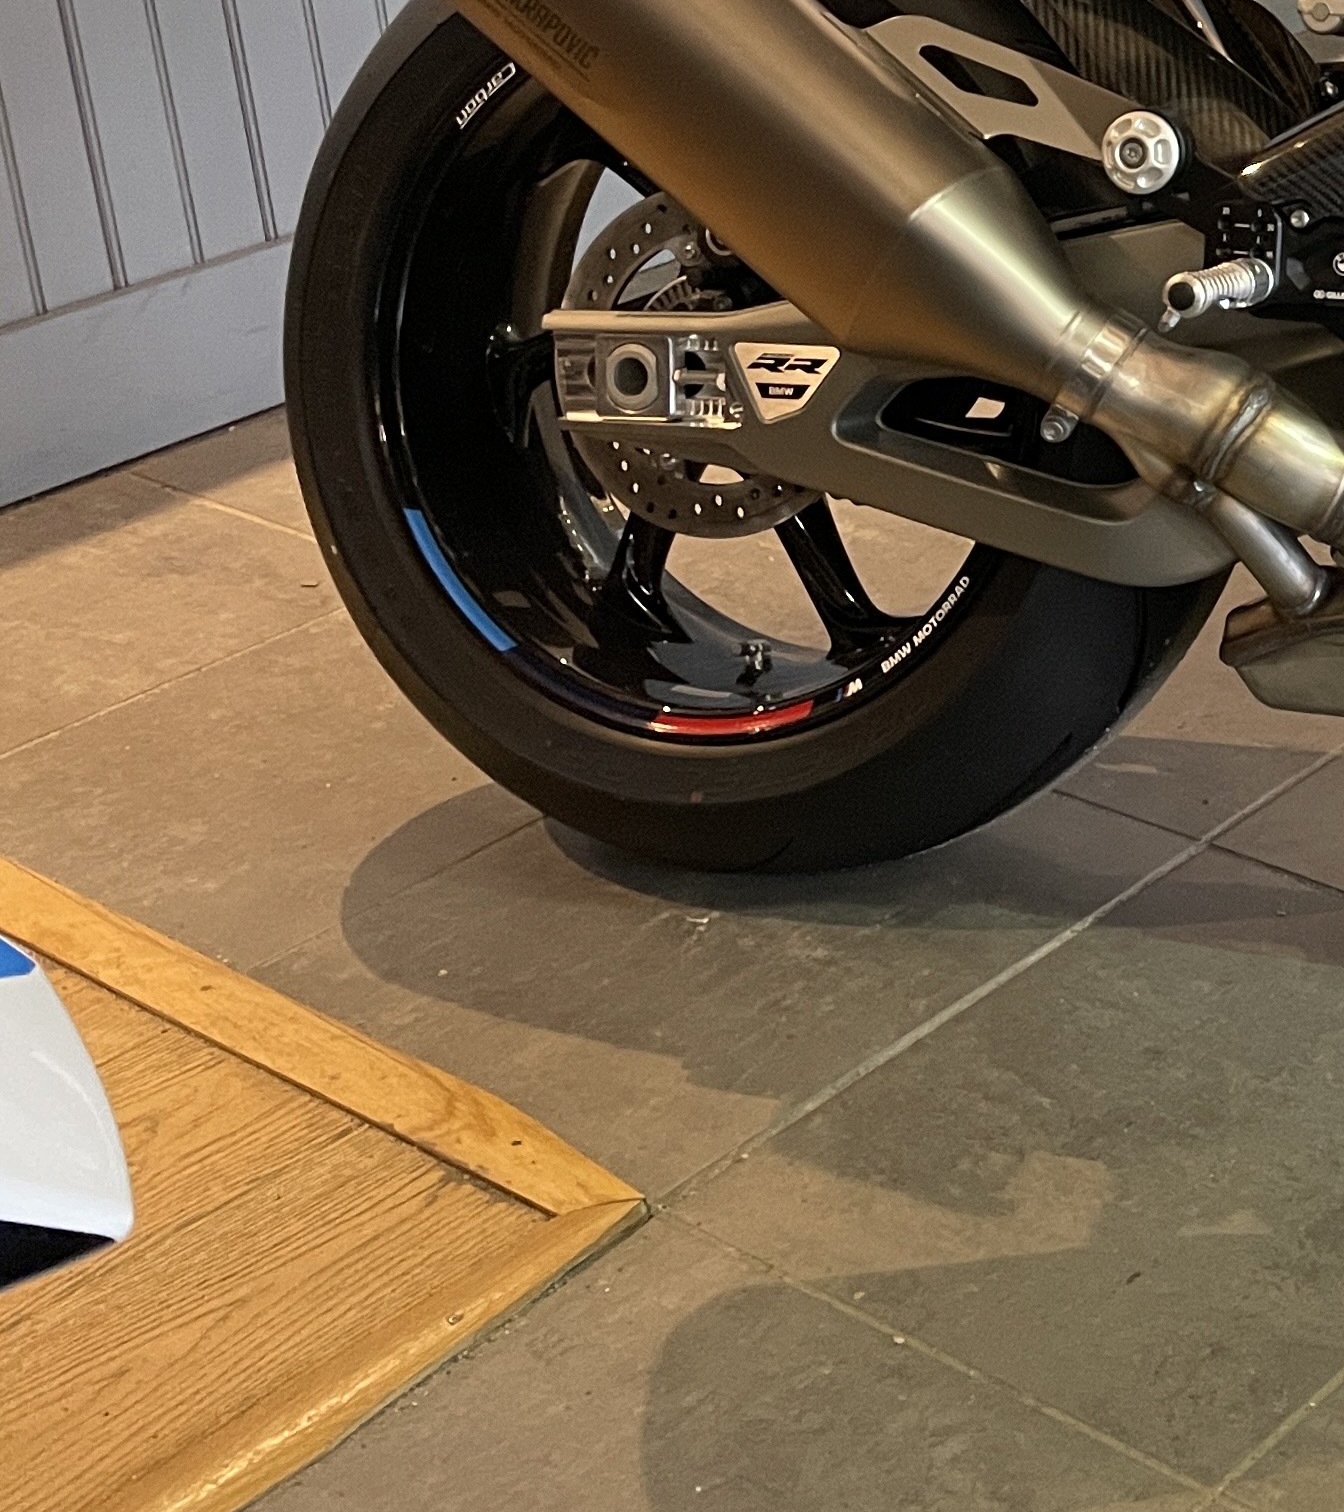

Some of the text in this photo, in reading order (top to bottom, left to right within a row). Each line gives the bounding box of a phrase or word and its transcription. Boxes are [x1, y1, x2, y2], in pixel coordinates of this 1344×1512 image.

[455, 61, 517, 130] Carbon
[747, 355, 829, 375] RR
[768, 386, 795, 396] BMW
[880, 575, 970, 674] BMW MOTORRAD
